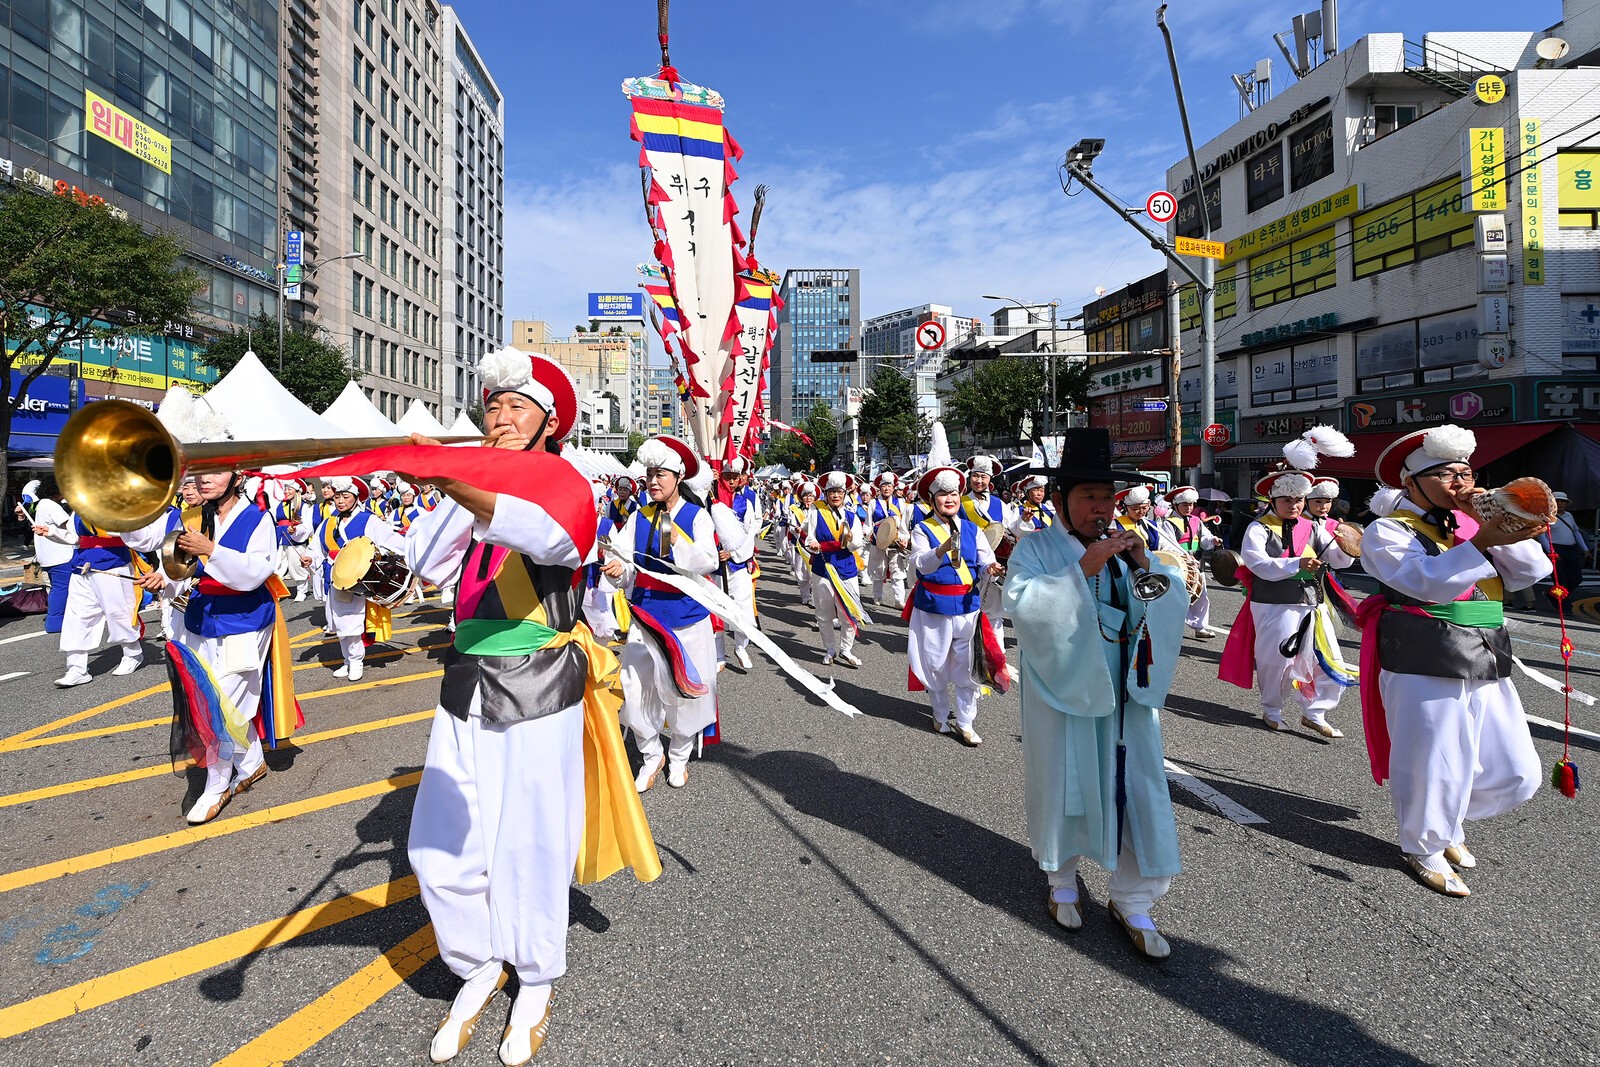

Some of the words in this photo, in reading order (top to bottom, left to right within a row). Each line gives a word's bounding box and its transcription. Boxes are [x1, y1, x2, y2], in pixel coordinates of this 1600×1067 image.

[1478, 81, 1503, 95] 타투
[91, 100, 133, 150] 임대
[135, 122, 150, 134] 010-
[134, 140, 150, 151] 010-
[1216, 122, 1279, 171] TATTOO
[1289, 103, 1311, 125] 타투
[1293, 126, 1333, 158] TATTOO
[1254, 155, 1280, 182] 타투
[1152, 200, 1171, 214] 50
[1239, 232, 1256, 250] 가나
[1259, 218, 1286, 242] 손주영
[1290, 198, 1332, 228] 성형외과
[1334, 194, 1350, 208] 의원
[1487, 231, 1504, 240] 안과
[1178, 240, 1222, 257] 신호과속단속장비
[1527, 258, 1540, 282] 경력
[82, 366, 95, 378] 상담
[1371, 418, 1393, 426] WORLD
[1425, 412, 1446, 422] olleh
[1482, 407, 1506, 417] LGU+
[1208, 427, 1225, 436] 정지
